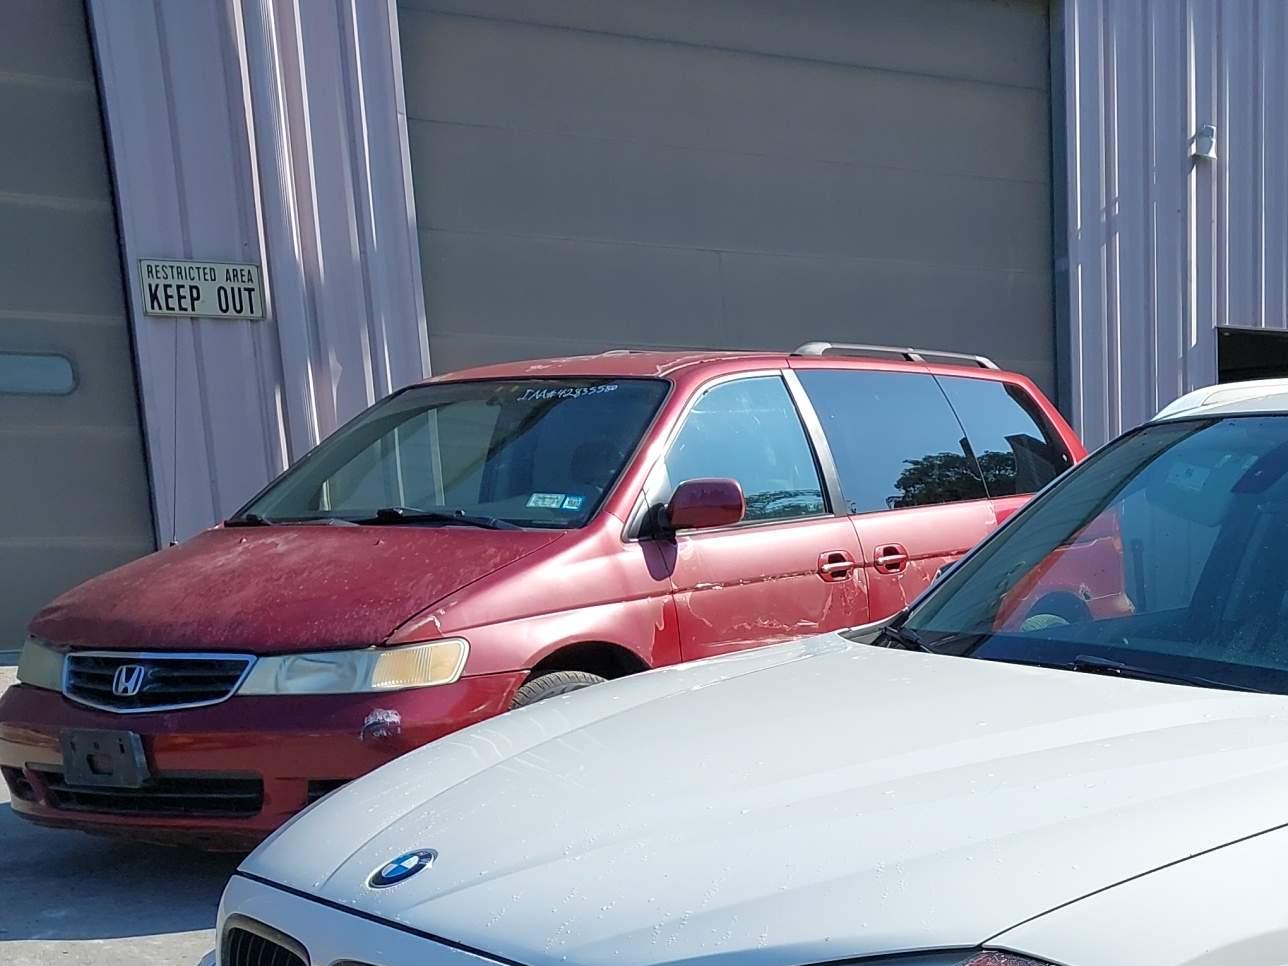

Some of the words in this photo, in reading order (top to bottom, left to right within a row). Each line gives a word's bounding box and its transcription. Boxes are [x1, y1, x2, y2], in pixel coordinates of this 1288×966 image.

[146, 264, 217, 281] RESTRICTED
[225, 268, 254, 283] AREA
[148, 283, 200, 312] KEEP
[217, 286, 255, 314] OUT
